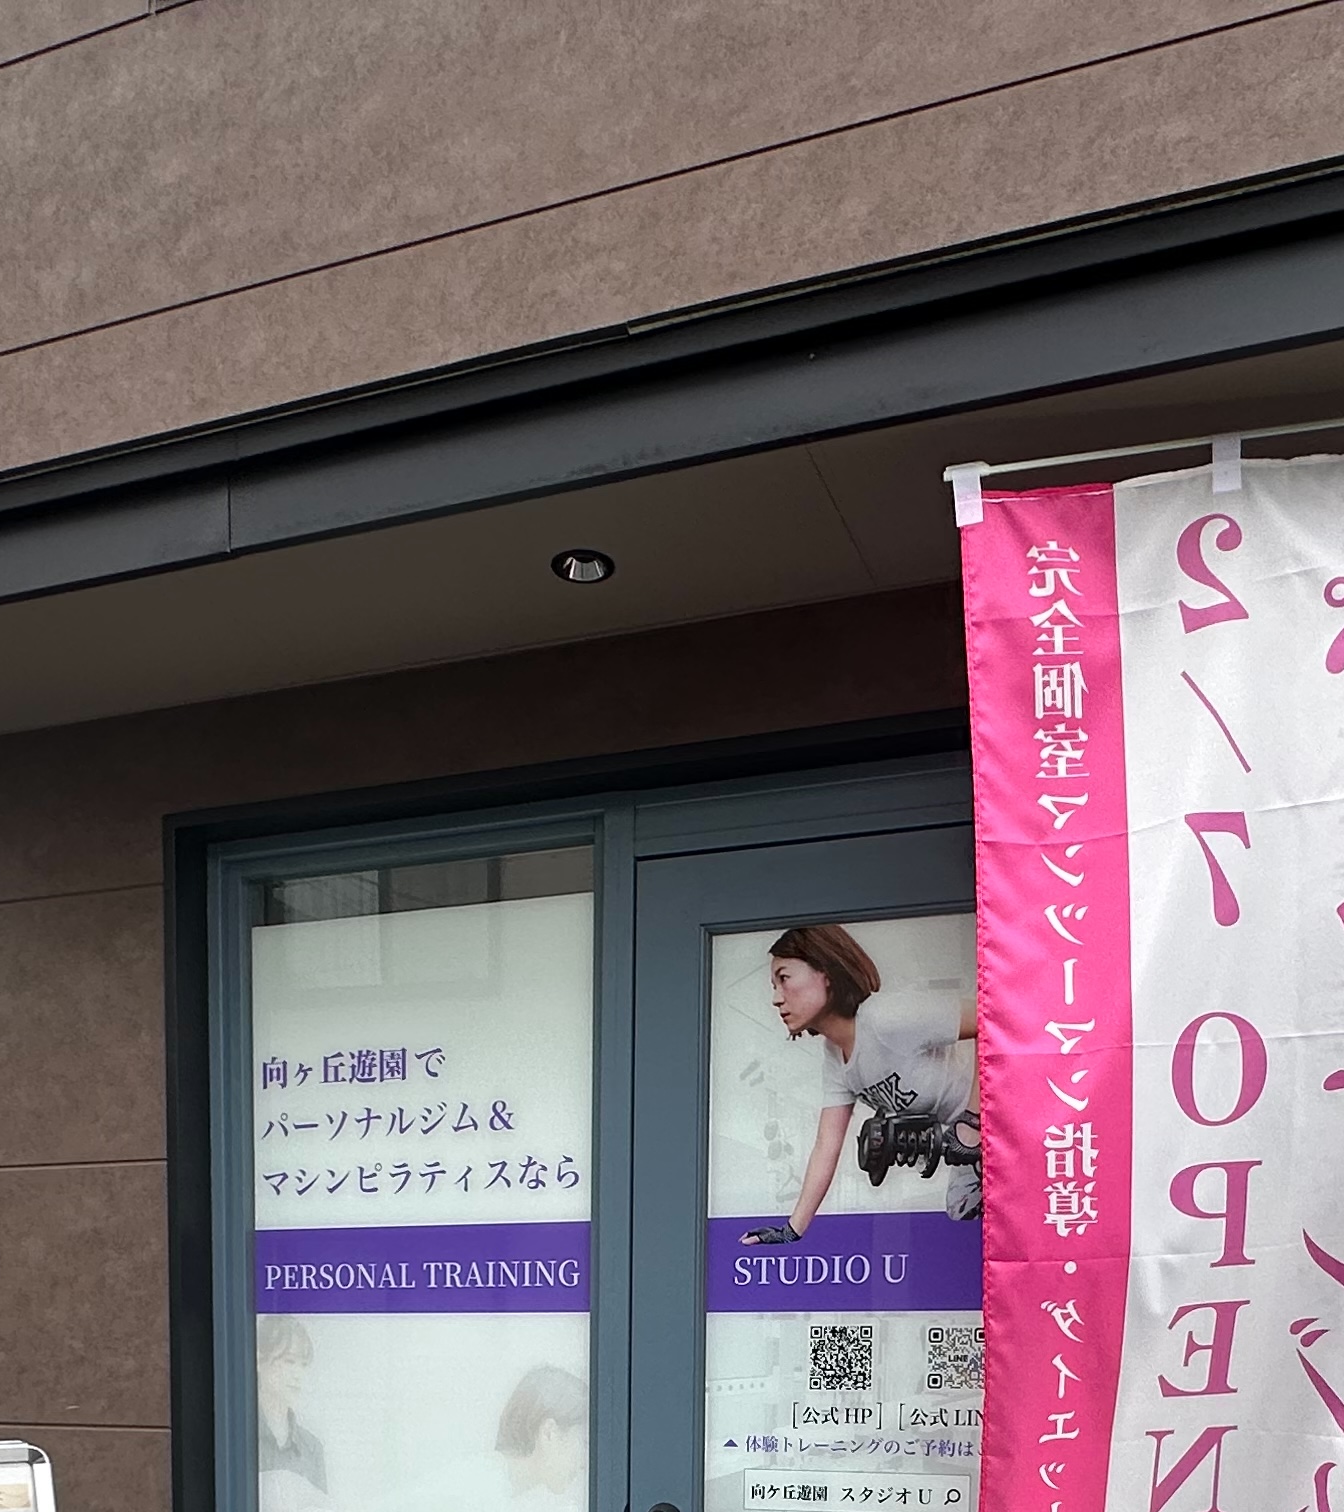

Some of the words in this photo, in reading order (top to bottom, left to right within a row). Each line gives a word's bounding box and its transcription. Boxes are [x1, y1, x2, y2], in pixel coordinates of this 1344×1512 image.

[262, 1155, 581, 1196] マシンピラティスなら
[265, 1262, 416, 1290] PERSONAL
[423, 1259, 581, 1288] TRAINING
[733, 1255, 870, 1286] STUDIO
[882, 1254, 909, 1284] U
[948, 1354, 969, 1363] LINE
[745, 1435, 983, 1458] 体験トレーニングのご予約は
